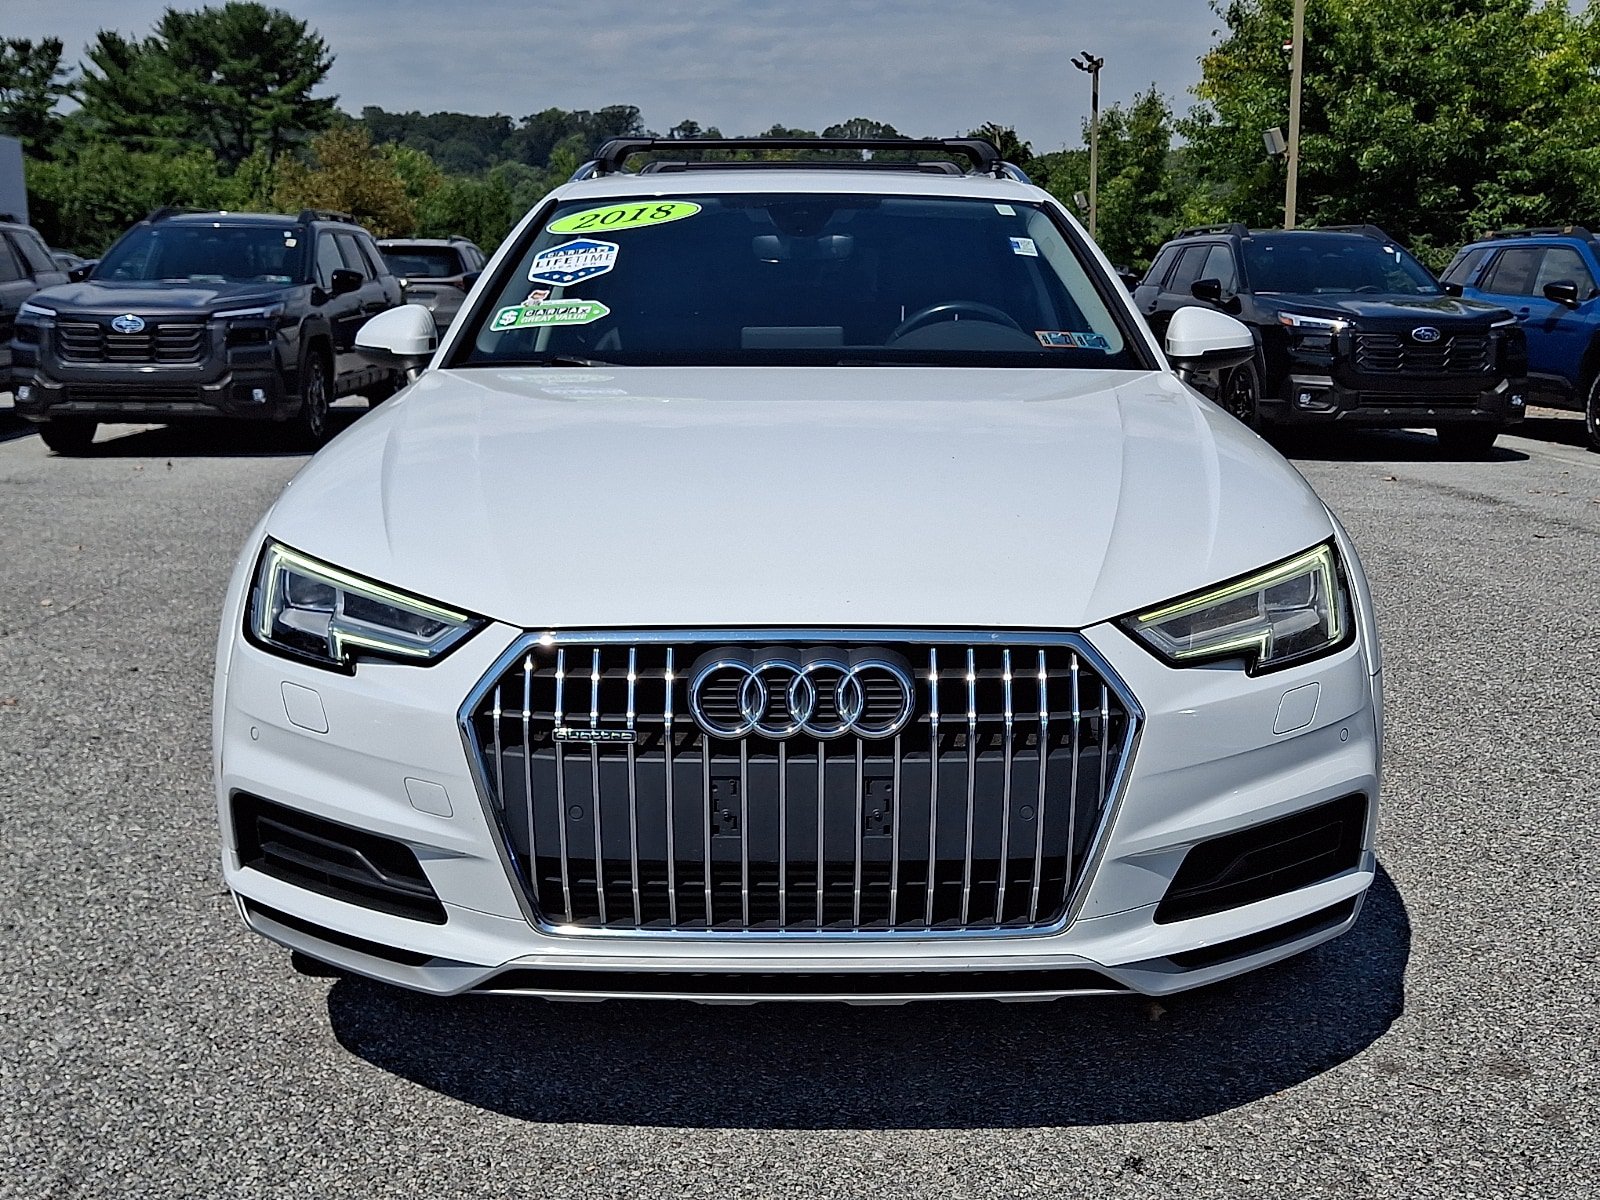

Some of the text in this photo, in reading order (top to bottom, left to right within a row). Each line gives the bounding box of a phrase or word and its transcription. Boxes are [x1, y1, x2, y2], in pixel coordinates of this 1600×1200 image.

[571, 204, 676, 231] 2018
[545, 246, 609, 259] CARFAX
[535, 253, 613, 269] LIFETIME
[550, 262, 597, 270] DEALER
[524, 306, 592, 317] CARFAX
[521, 313, 588, 324] GREAT VALUE
